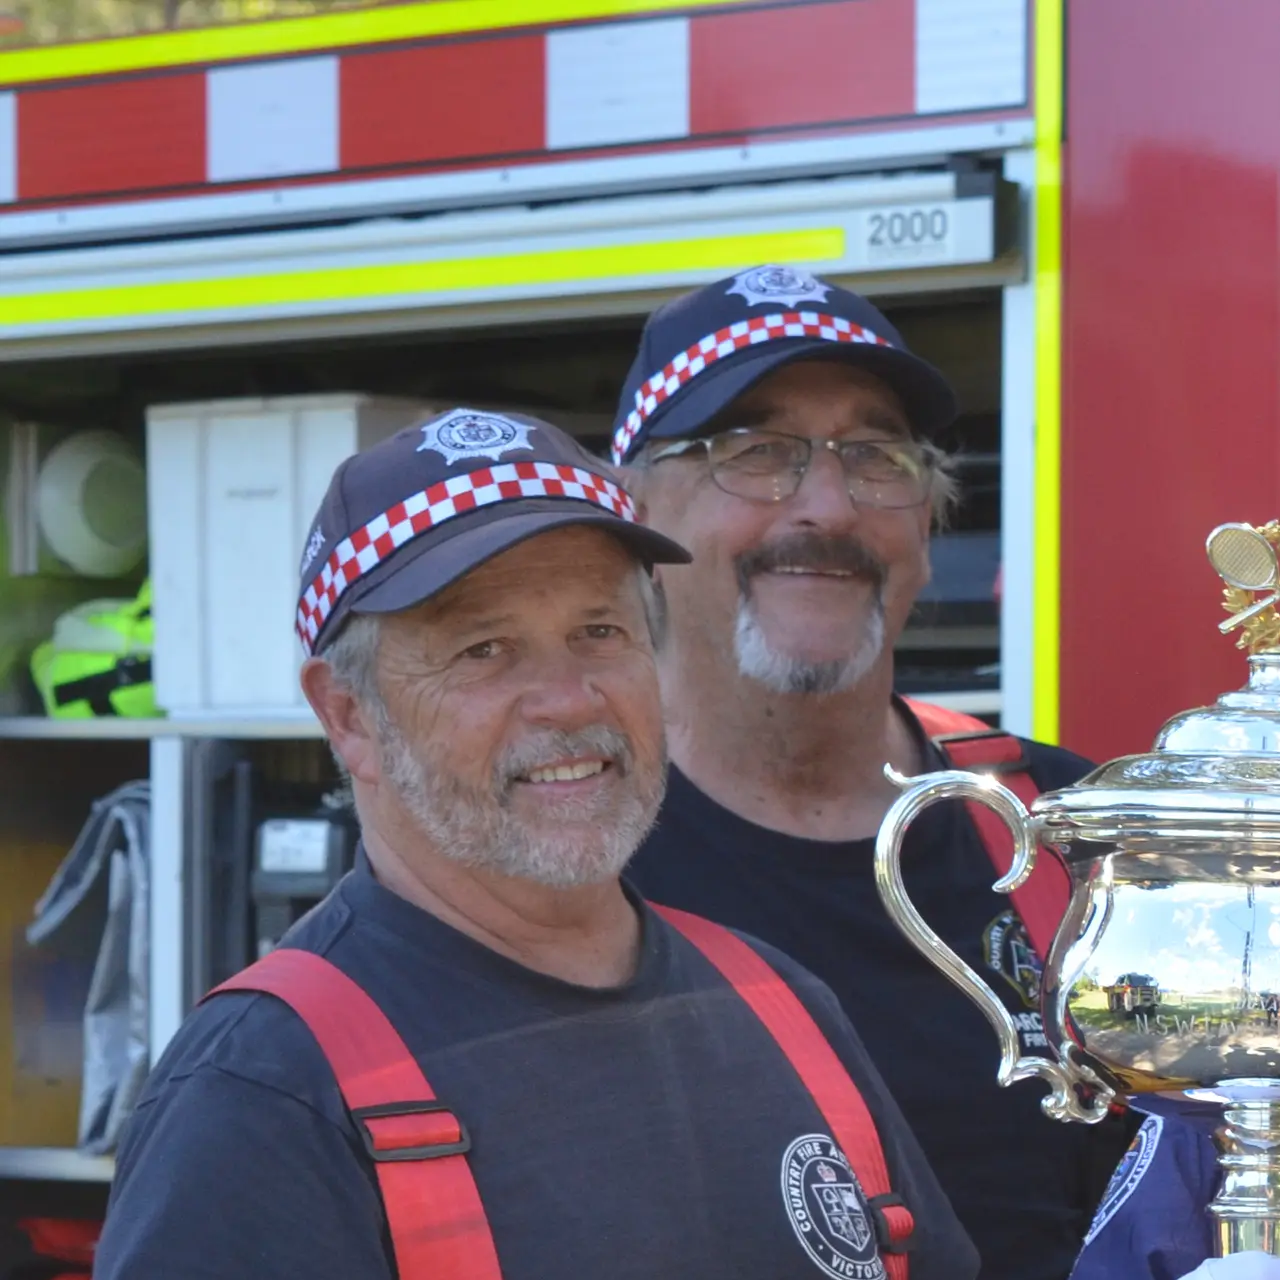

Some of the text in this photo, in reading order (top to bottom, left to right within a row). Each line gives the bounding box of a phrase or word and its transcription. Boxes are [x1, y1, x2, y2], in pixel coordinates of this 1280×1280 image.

[868, 209, 949, 246] 2000
[990, 924, 1004, 970] OUNTRY
[789, 1141, 823, 1232] COUNTRY FIRE
[831, 1254, 884, 1277] VICTOR
